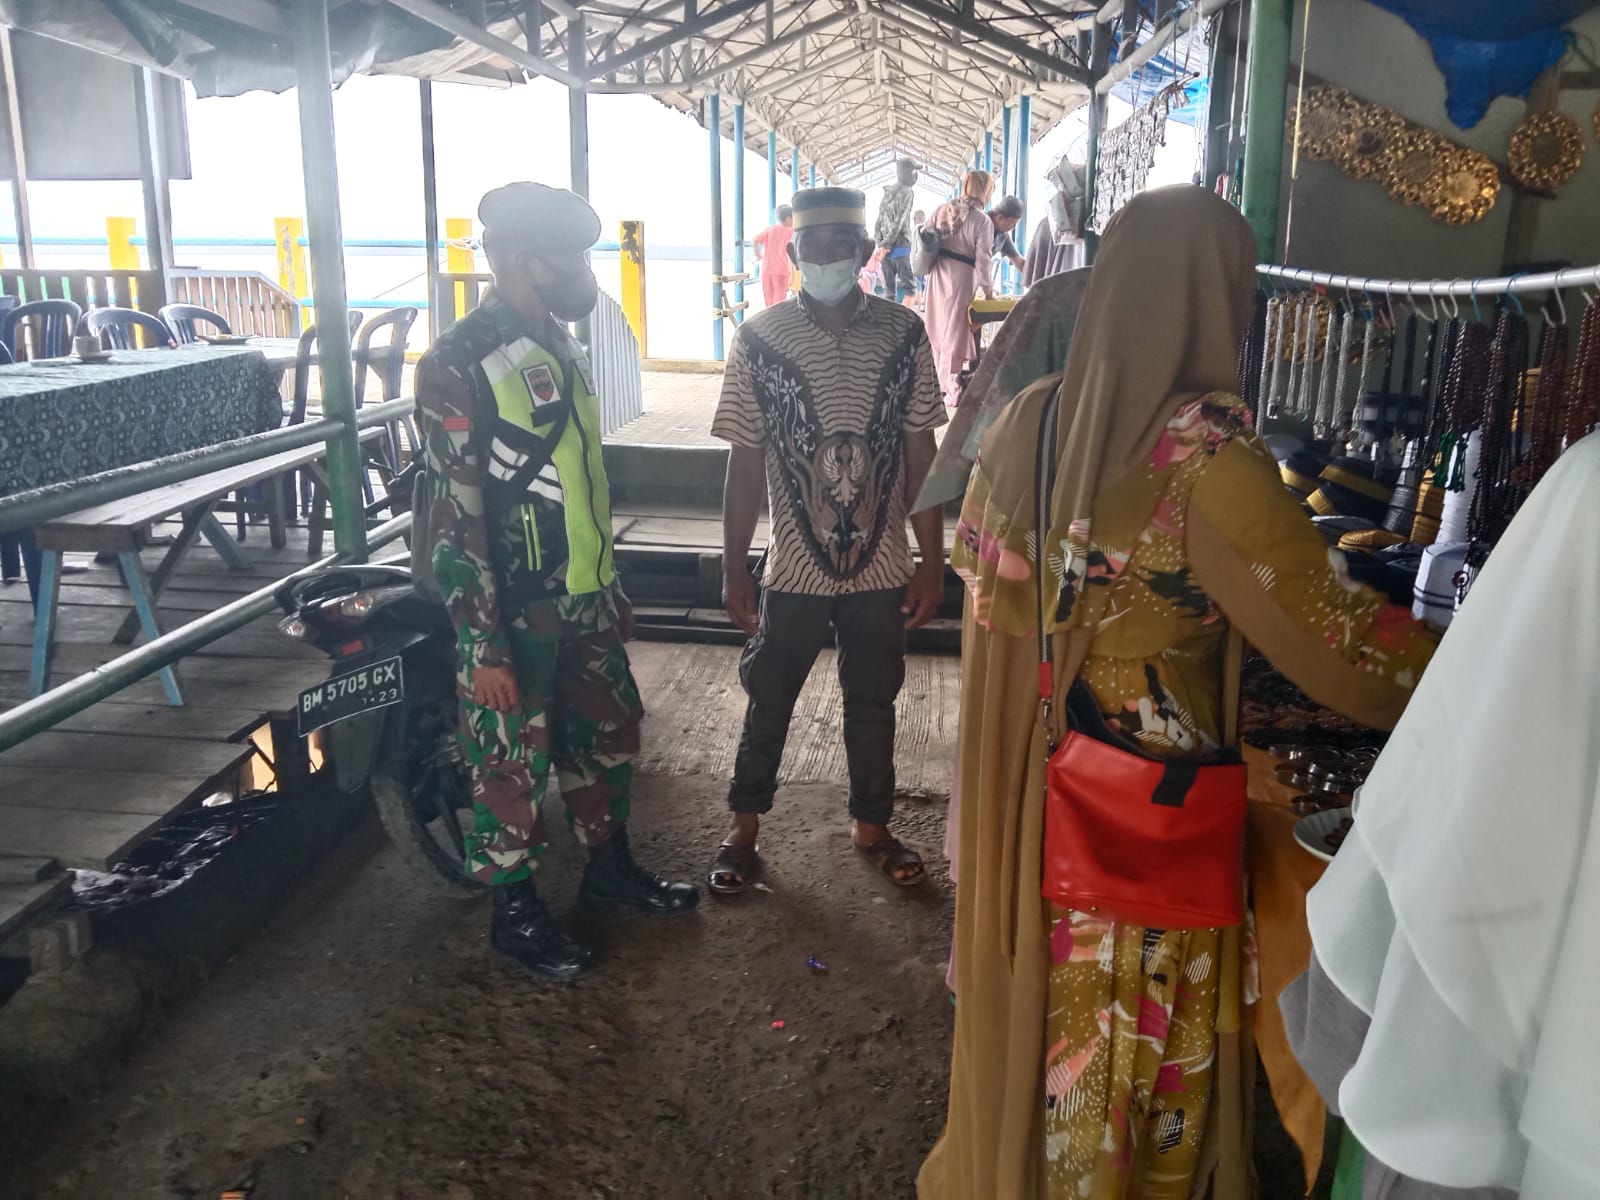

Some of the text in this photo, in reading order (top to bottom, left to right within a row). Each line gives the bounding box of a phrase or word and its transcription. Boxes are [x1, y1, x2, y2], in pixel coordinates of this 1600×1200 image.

[303, 663, 396, 712] BM 5705 GX
